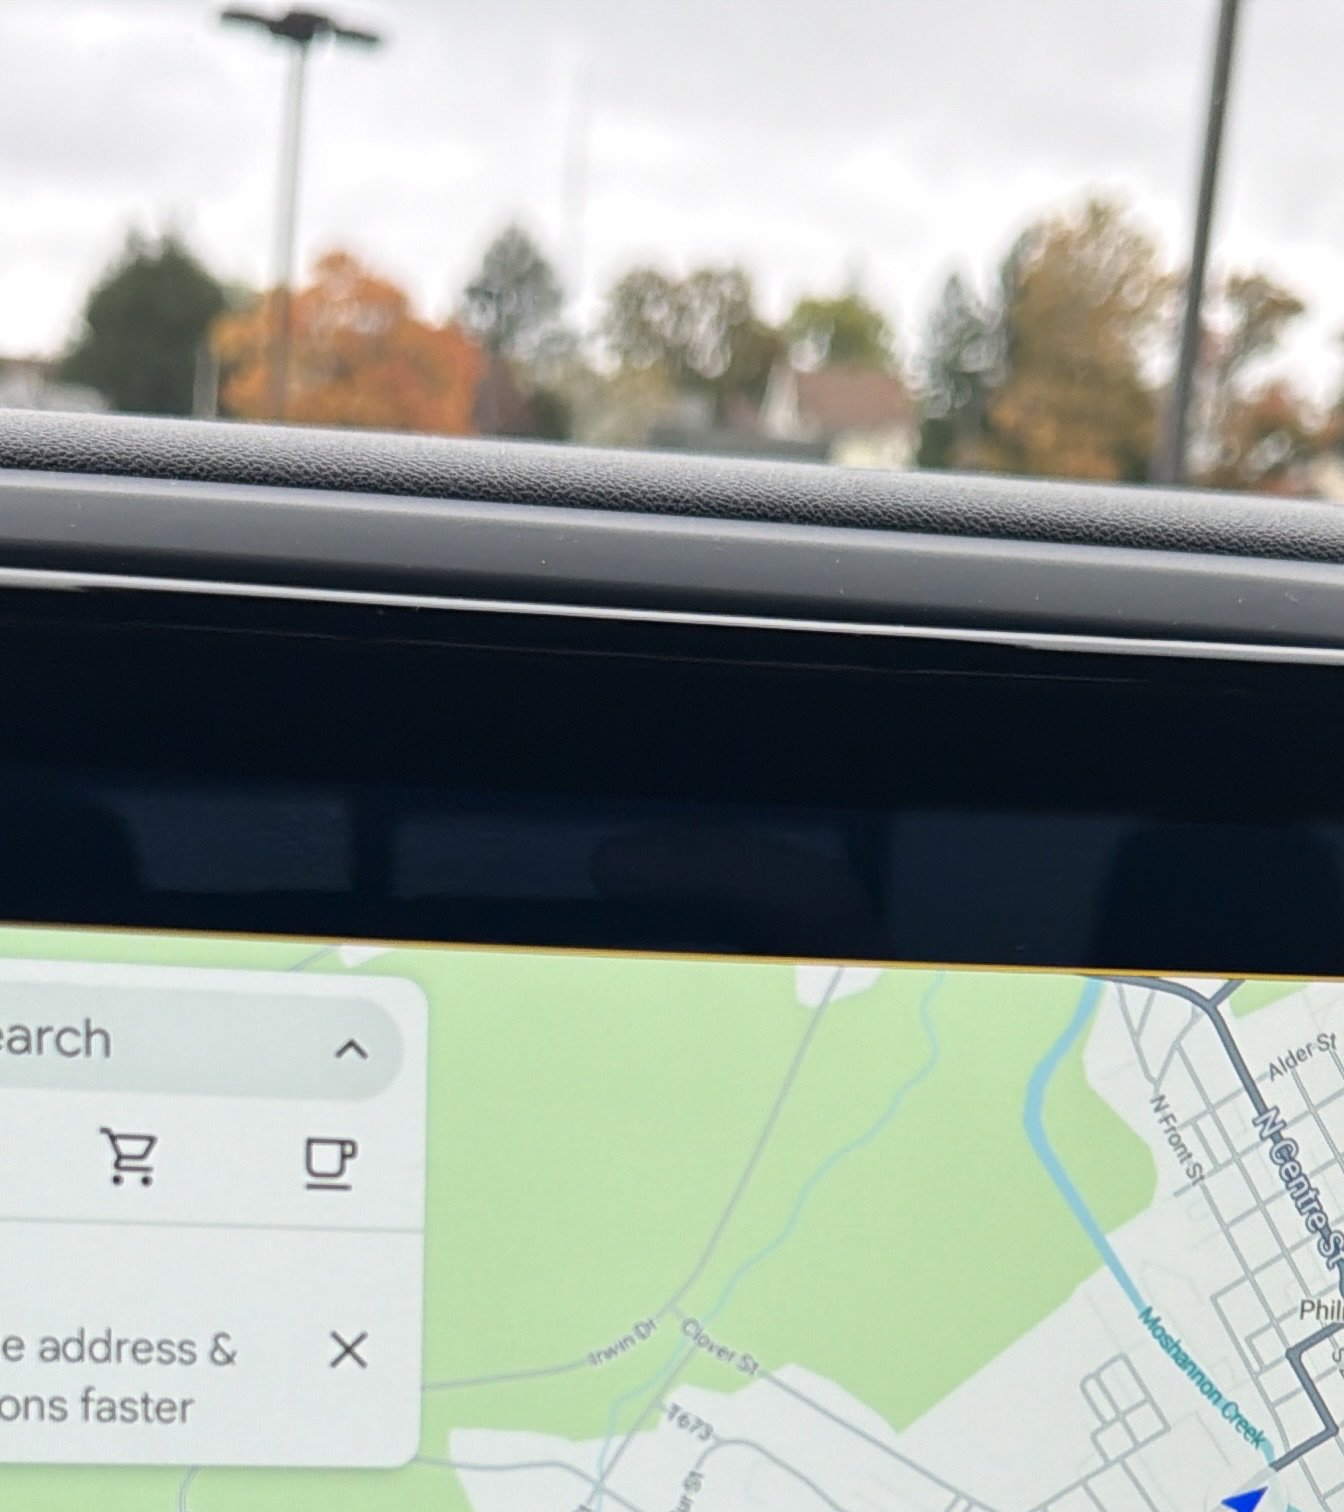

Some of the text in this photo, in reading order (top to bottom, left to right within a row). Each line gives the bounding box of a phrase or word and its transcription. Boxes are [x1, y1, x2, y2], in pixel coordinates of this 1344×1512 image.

[1268, 1032, 1337, 1081] Alder St
[1150, 1094, 1205, 1186] N Front St
[1253, 1105, 1287, 1141] N
[1269, 1138, 1330, 1232] Centre
[39, 1330, 197, 1367] address
[210, 1334, 237, 1368] &
[587, 1318, 657, 1366] Irwin Dr
[682, 1318, 759, 1375] Clover St
[1138, 1307, 1265, 1450] Moshannon Creek
[80, 1389, 193, 1425] faster
